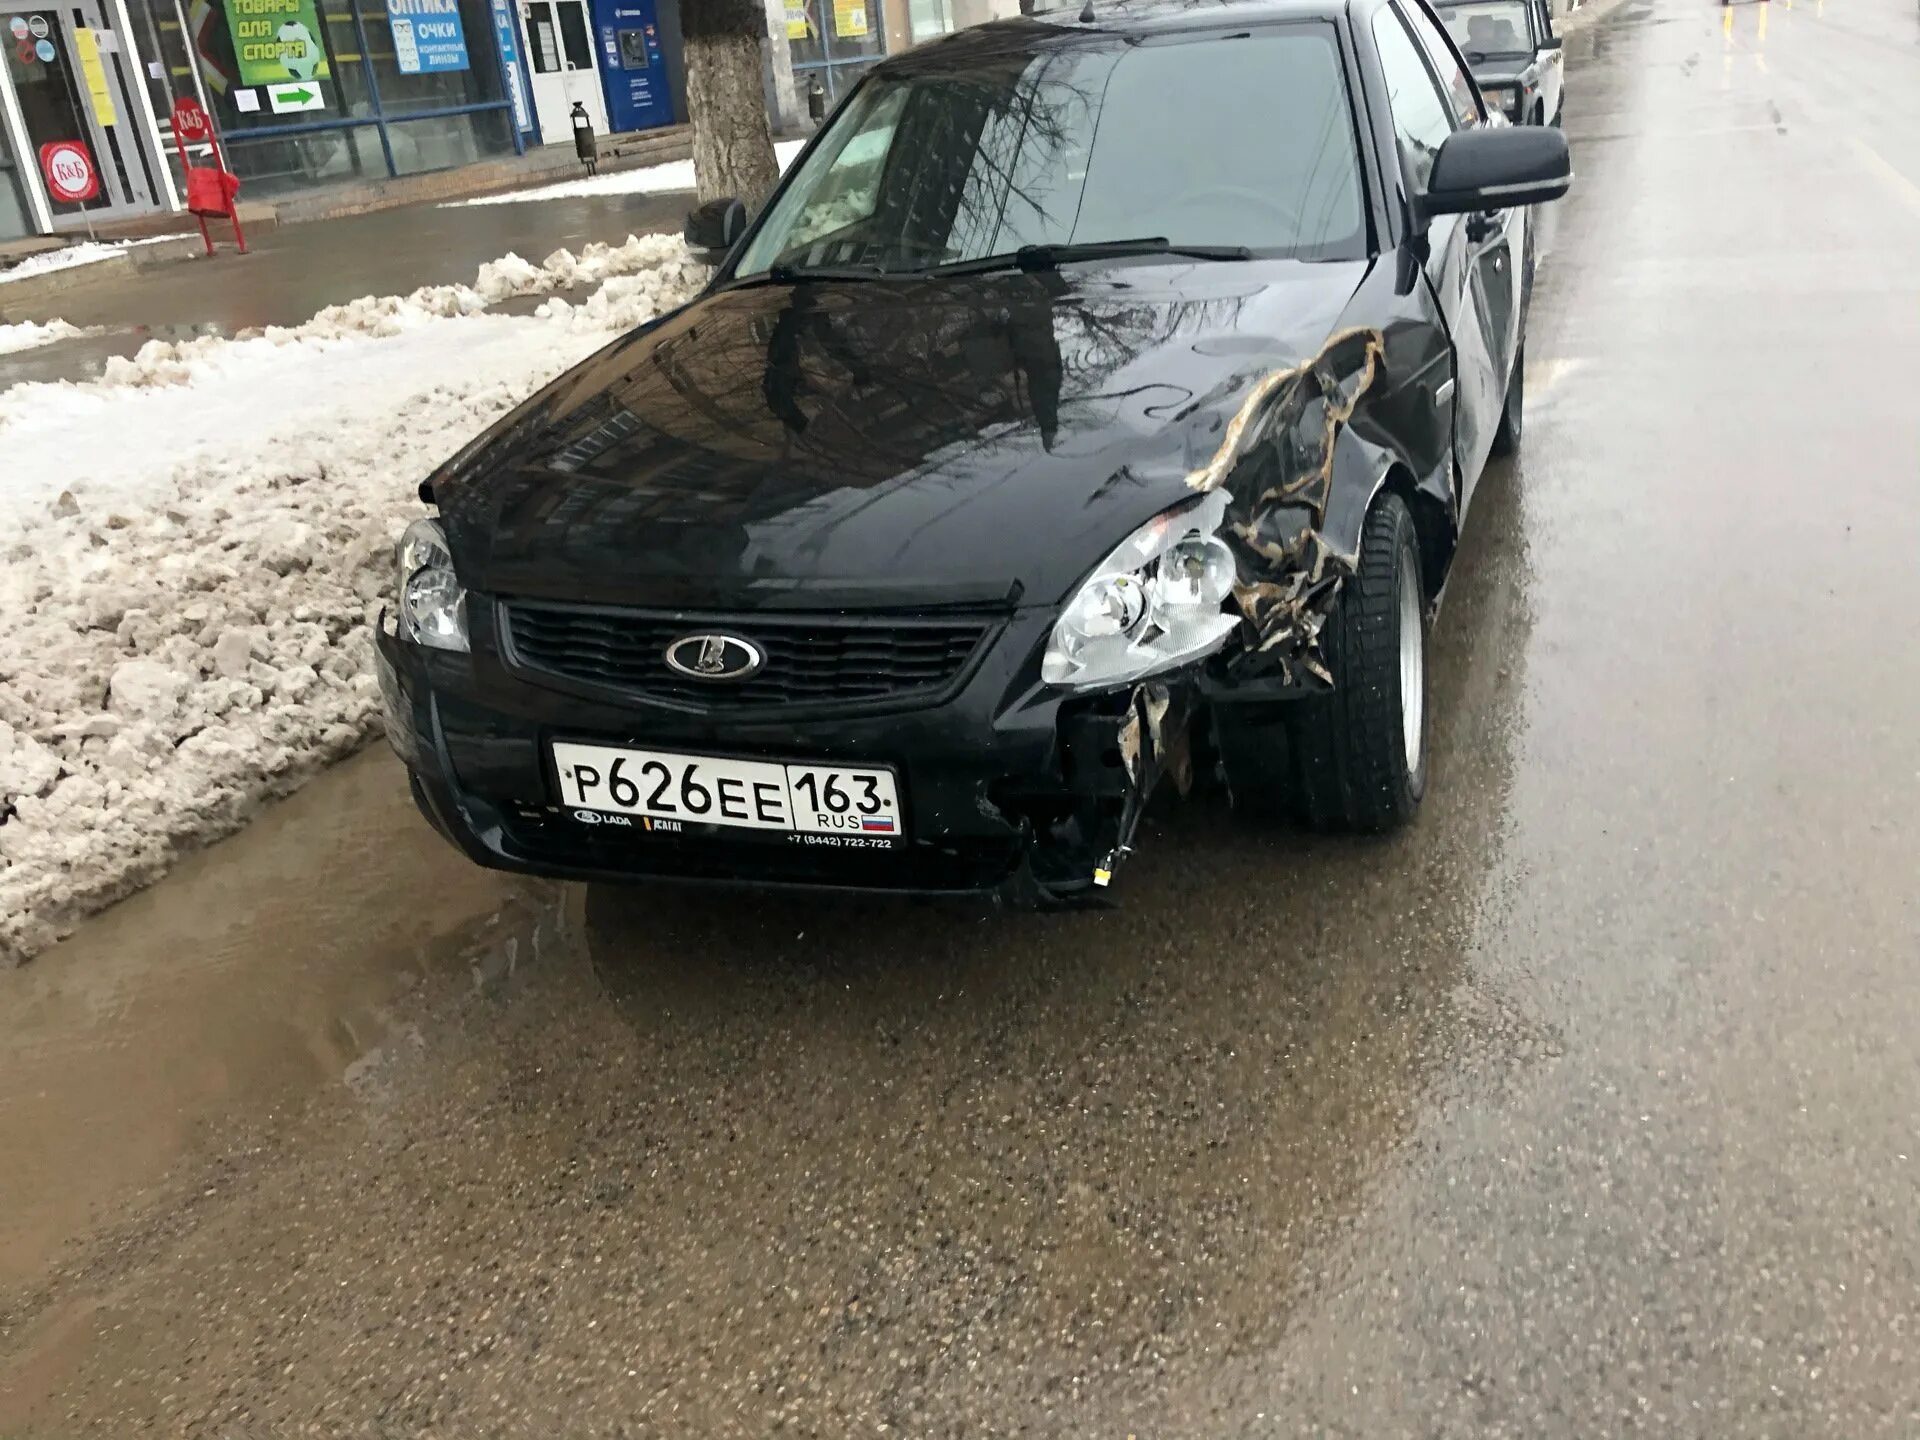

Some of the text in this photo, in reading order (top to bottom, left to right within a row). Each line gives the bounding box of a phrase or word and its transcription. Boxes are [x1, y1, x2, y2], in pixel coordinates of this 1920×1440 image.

[232, 0, 299, 14] ТОВАРЫ
[238, 20, 272, 37] ДЛЯ
[418, 22, 457, 39] ОЧКИ
[243, 41, 305, 60] СПОРТА
[55, 160, 85, 181] К&Б
[794, 772, 882, 813] 163
[603, 814, 632, 827] LADA
[817, 814, 860, 829] RUS
[787, 835, 893, 848] +7 (8442) 722-722
